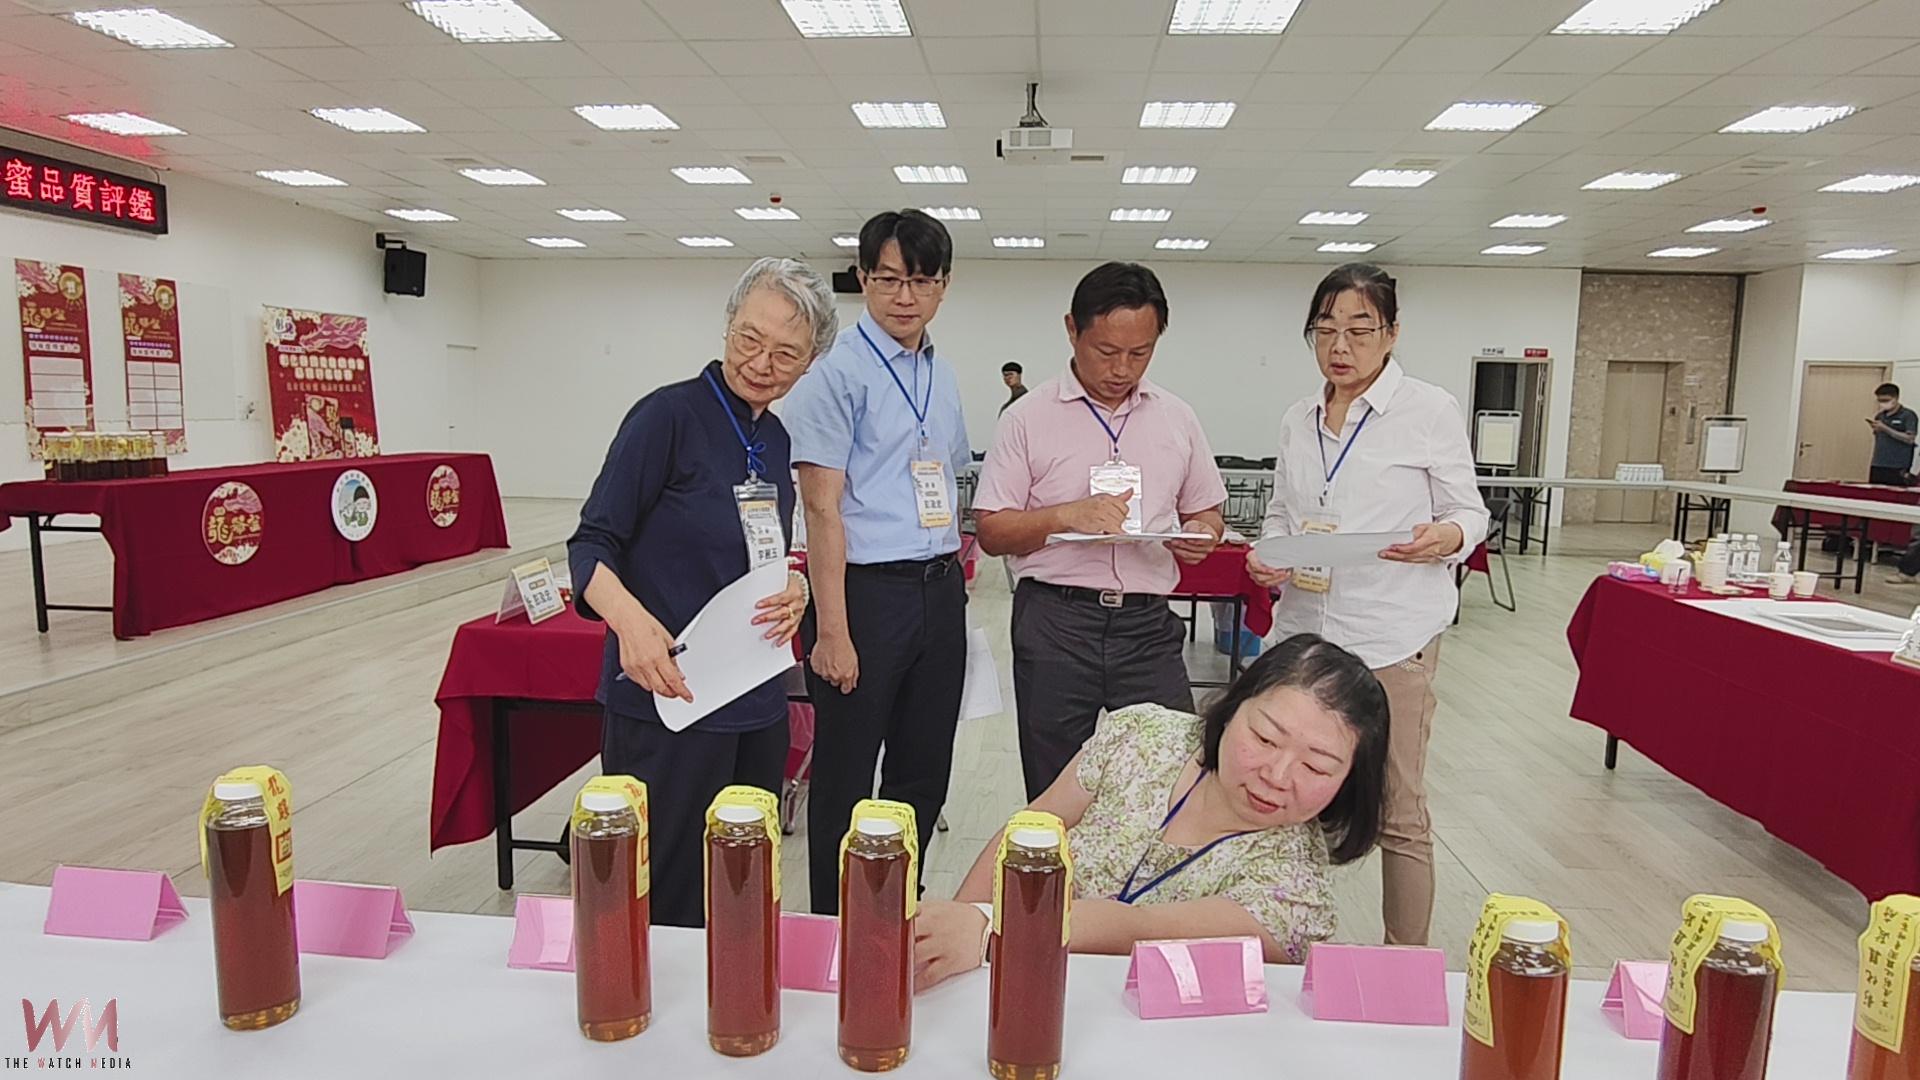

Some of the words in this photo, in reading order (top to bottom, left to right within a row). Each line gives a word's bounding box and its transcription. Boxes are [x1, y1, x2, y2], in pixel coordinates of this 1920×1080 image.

[3, 158, 156, 221] 蜜品質評鑑
